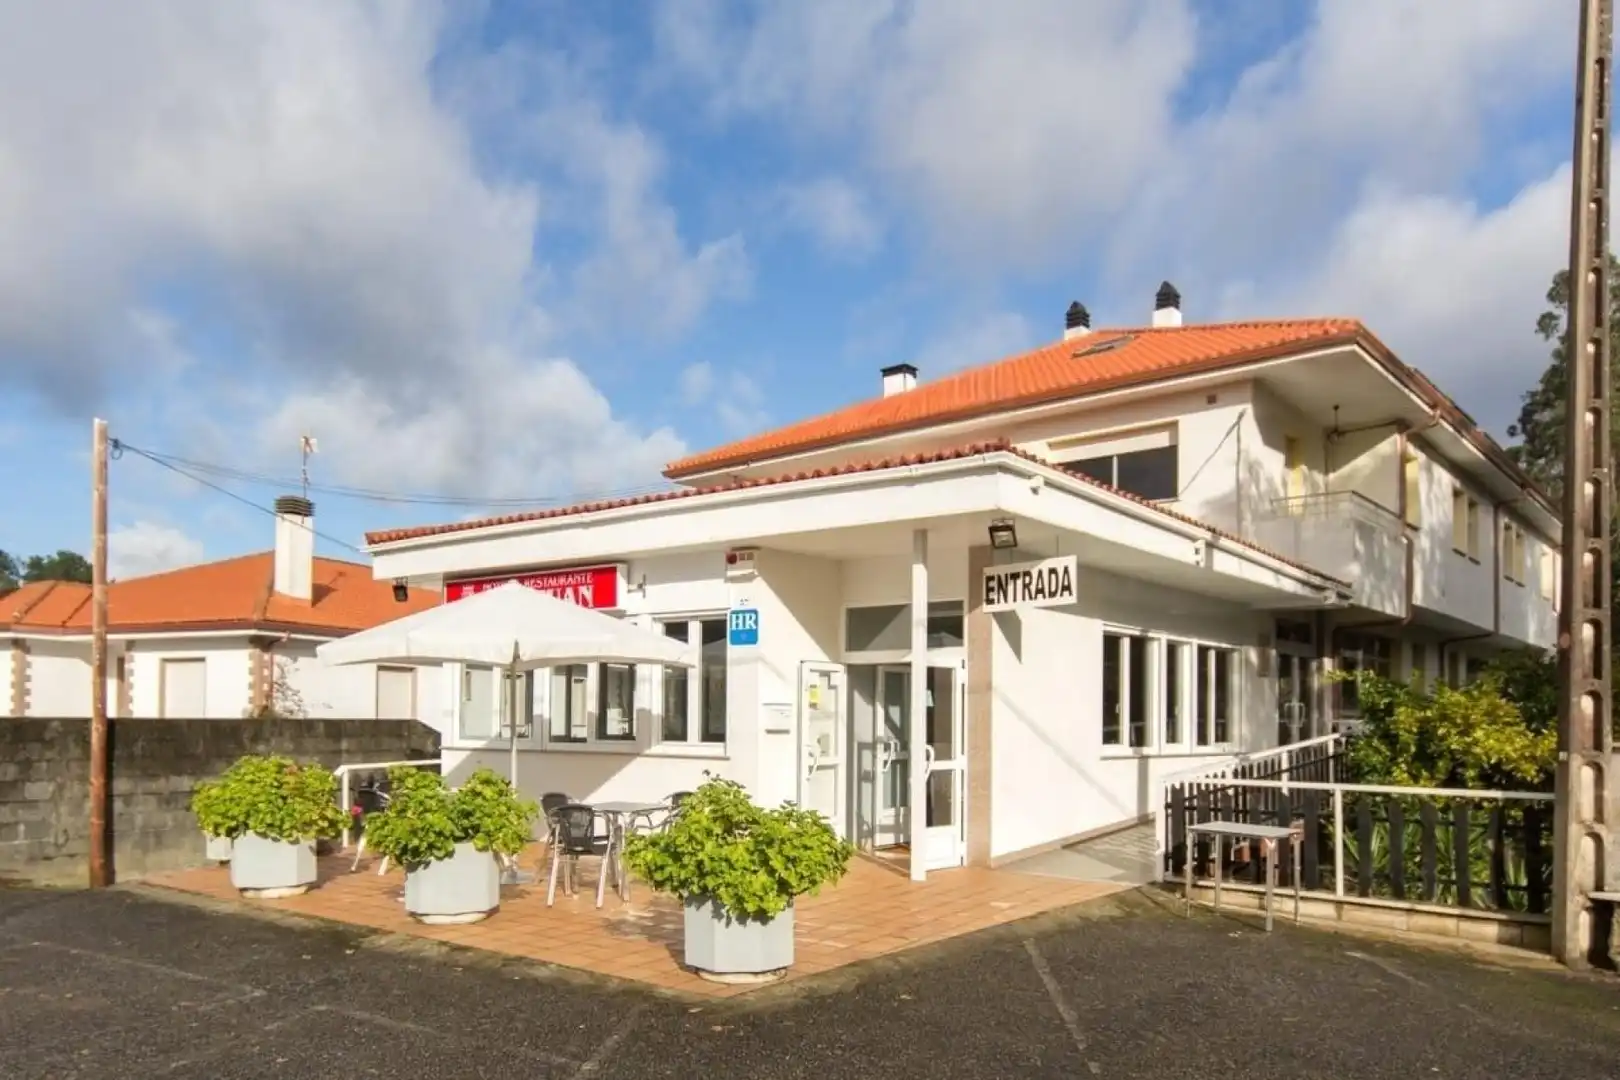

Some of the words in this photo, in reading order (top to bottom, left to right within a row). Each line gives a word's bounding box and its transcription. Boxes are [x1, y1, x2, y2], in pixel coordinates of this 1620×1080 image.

[524, 572, 593, 588] RESTAURANTE
[984, 565, 1073, 605] ENTRADA
[730, 613, 757, 630] HR
